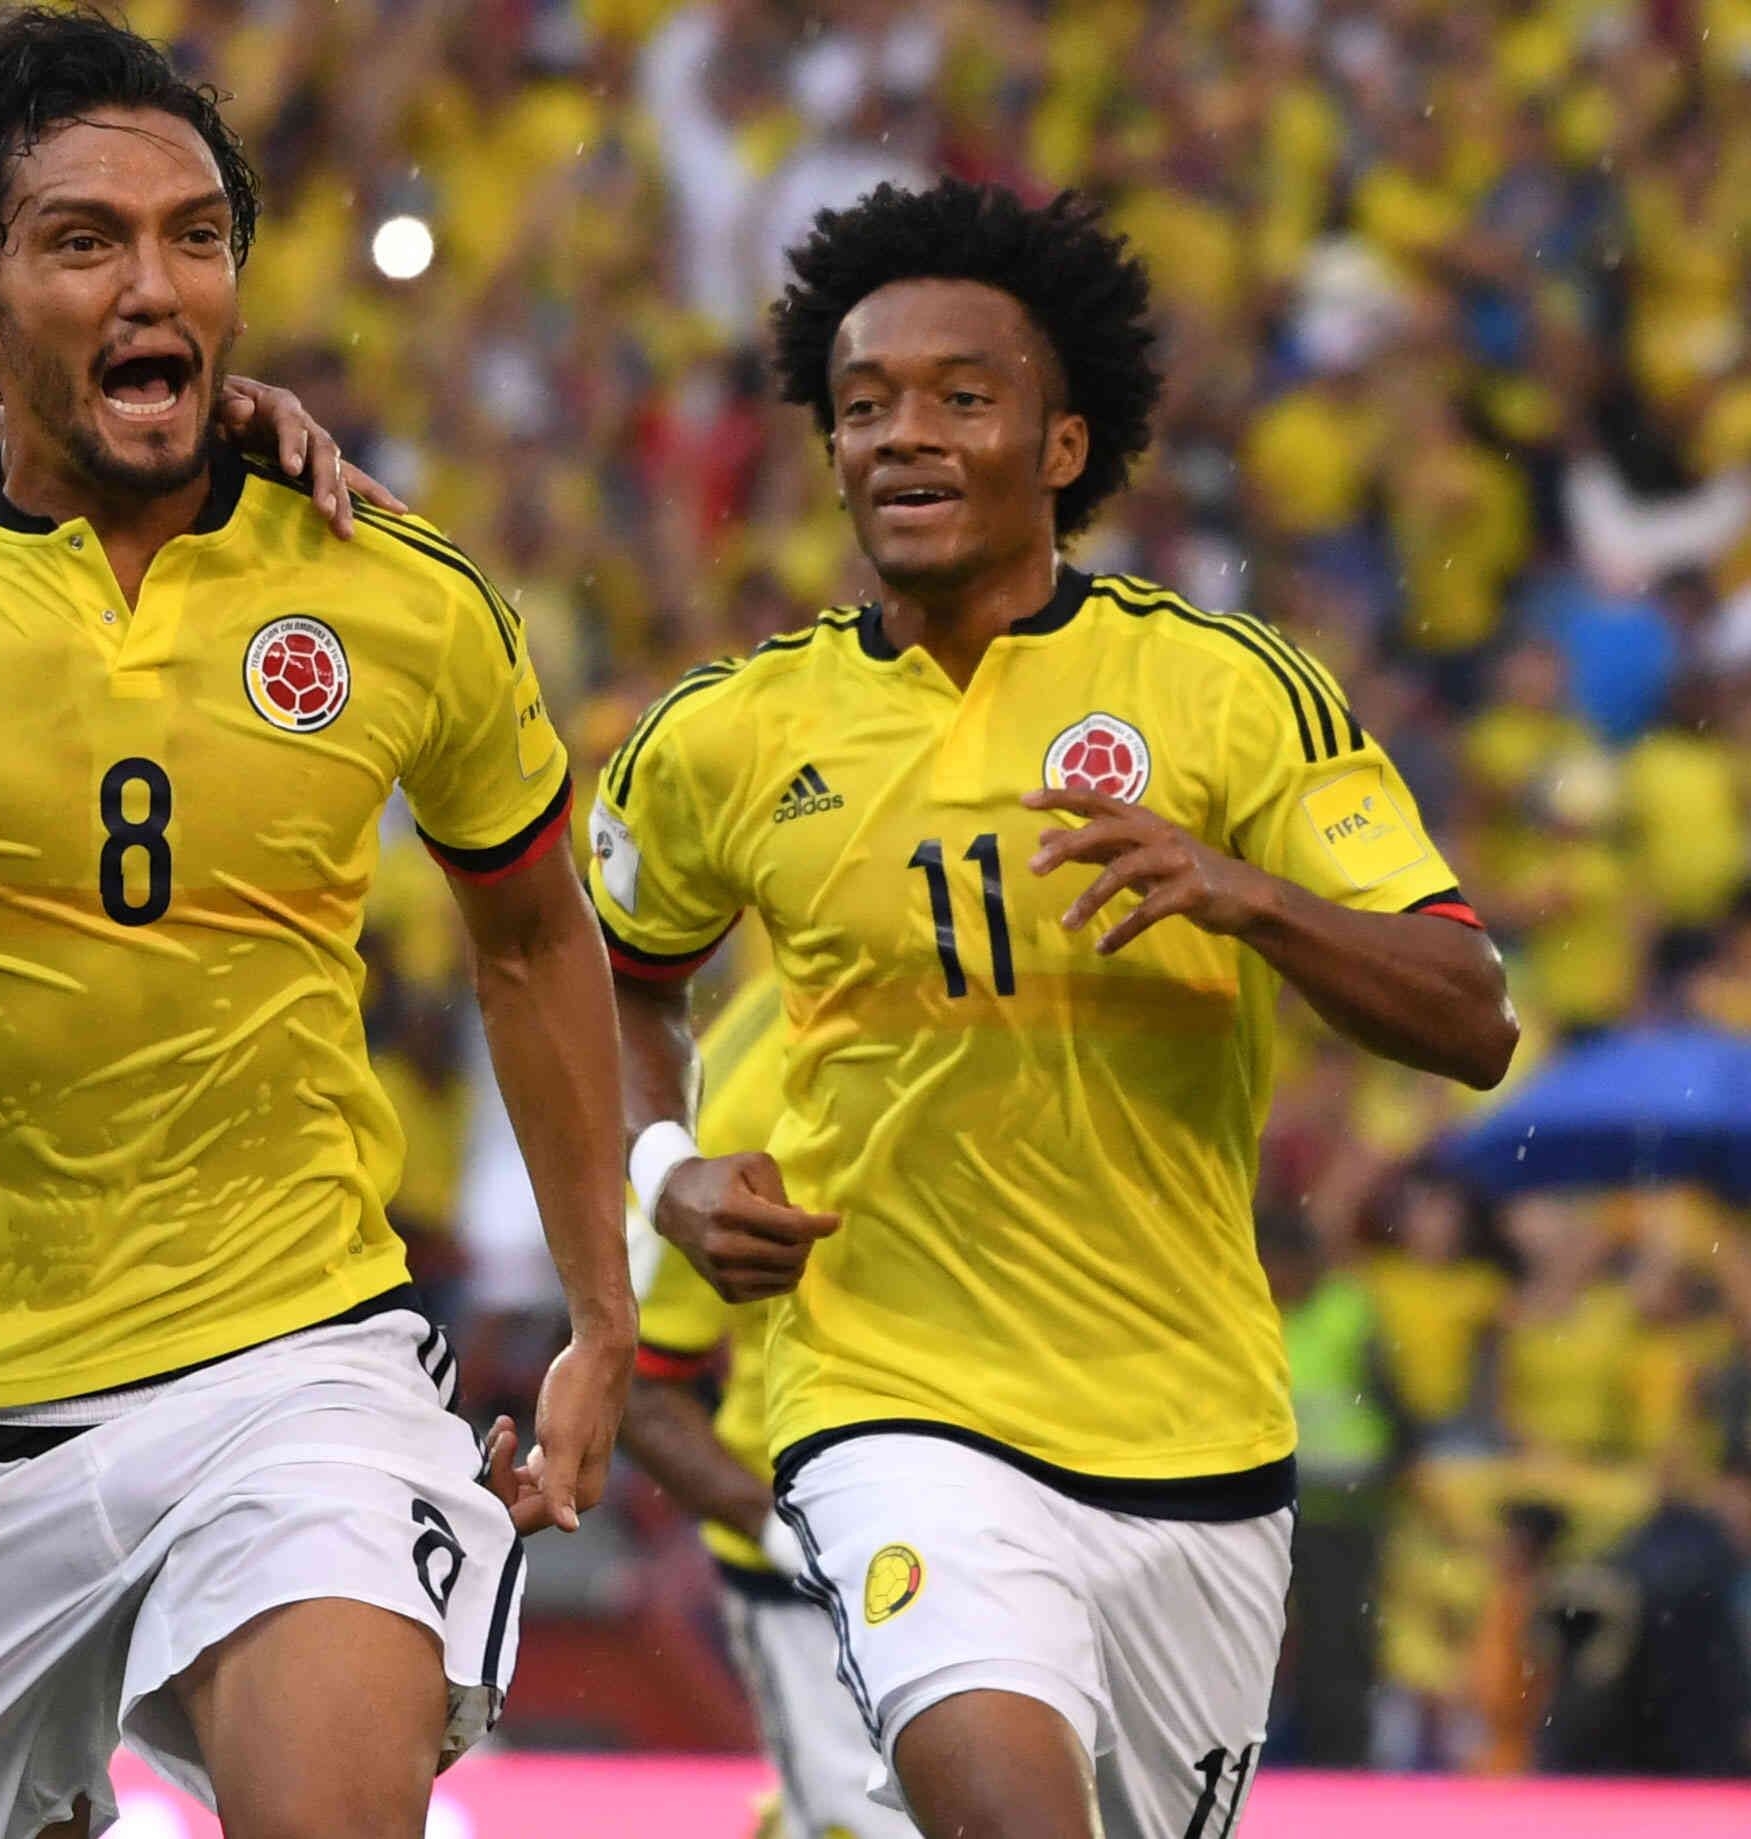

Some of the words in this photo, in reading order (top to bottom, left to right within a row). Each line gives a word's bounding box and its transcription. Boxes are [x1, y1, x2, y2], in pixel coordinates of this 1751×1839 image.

[99, 756, 172, 927] 8
[772, 791, 845, 825] adidas
[1324, 812, 1370, 845] FIFA
[907, 833, 1016, 998] 11
[1183, 1742, 1253, 1839] 11
